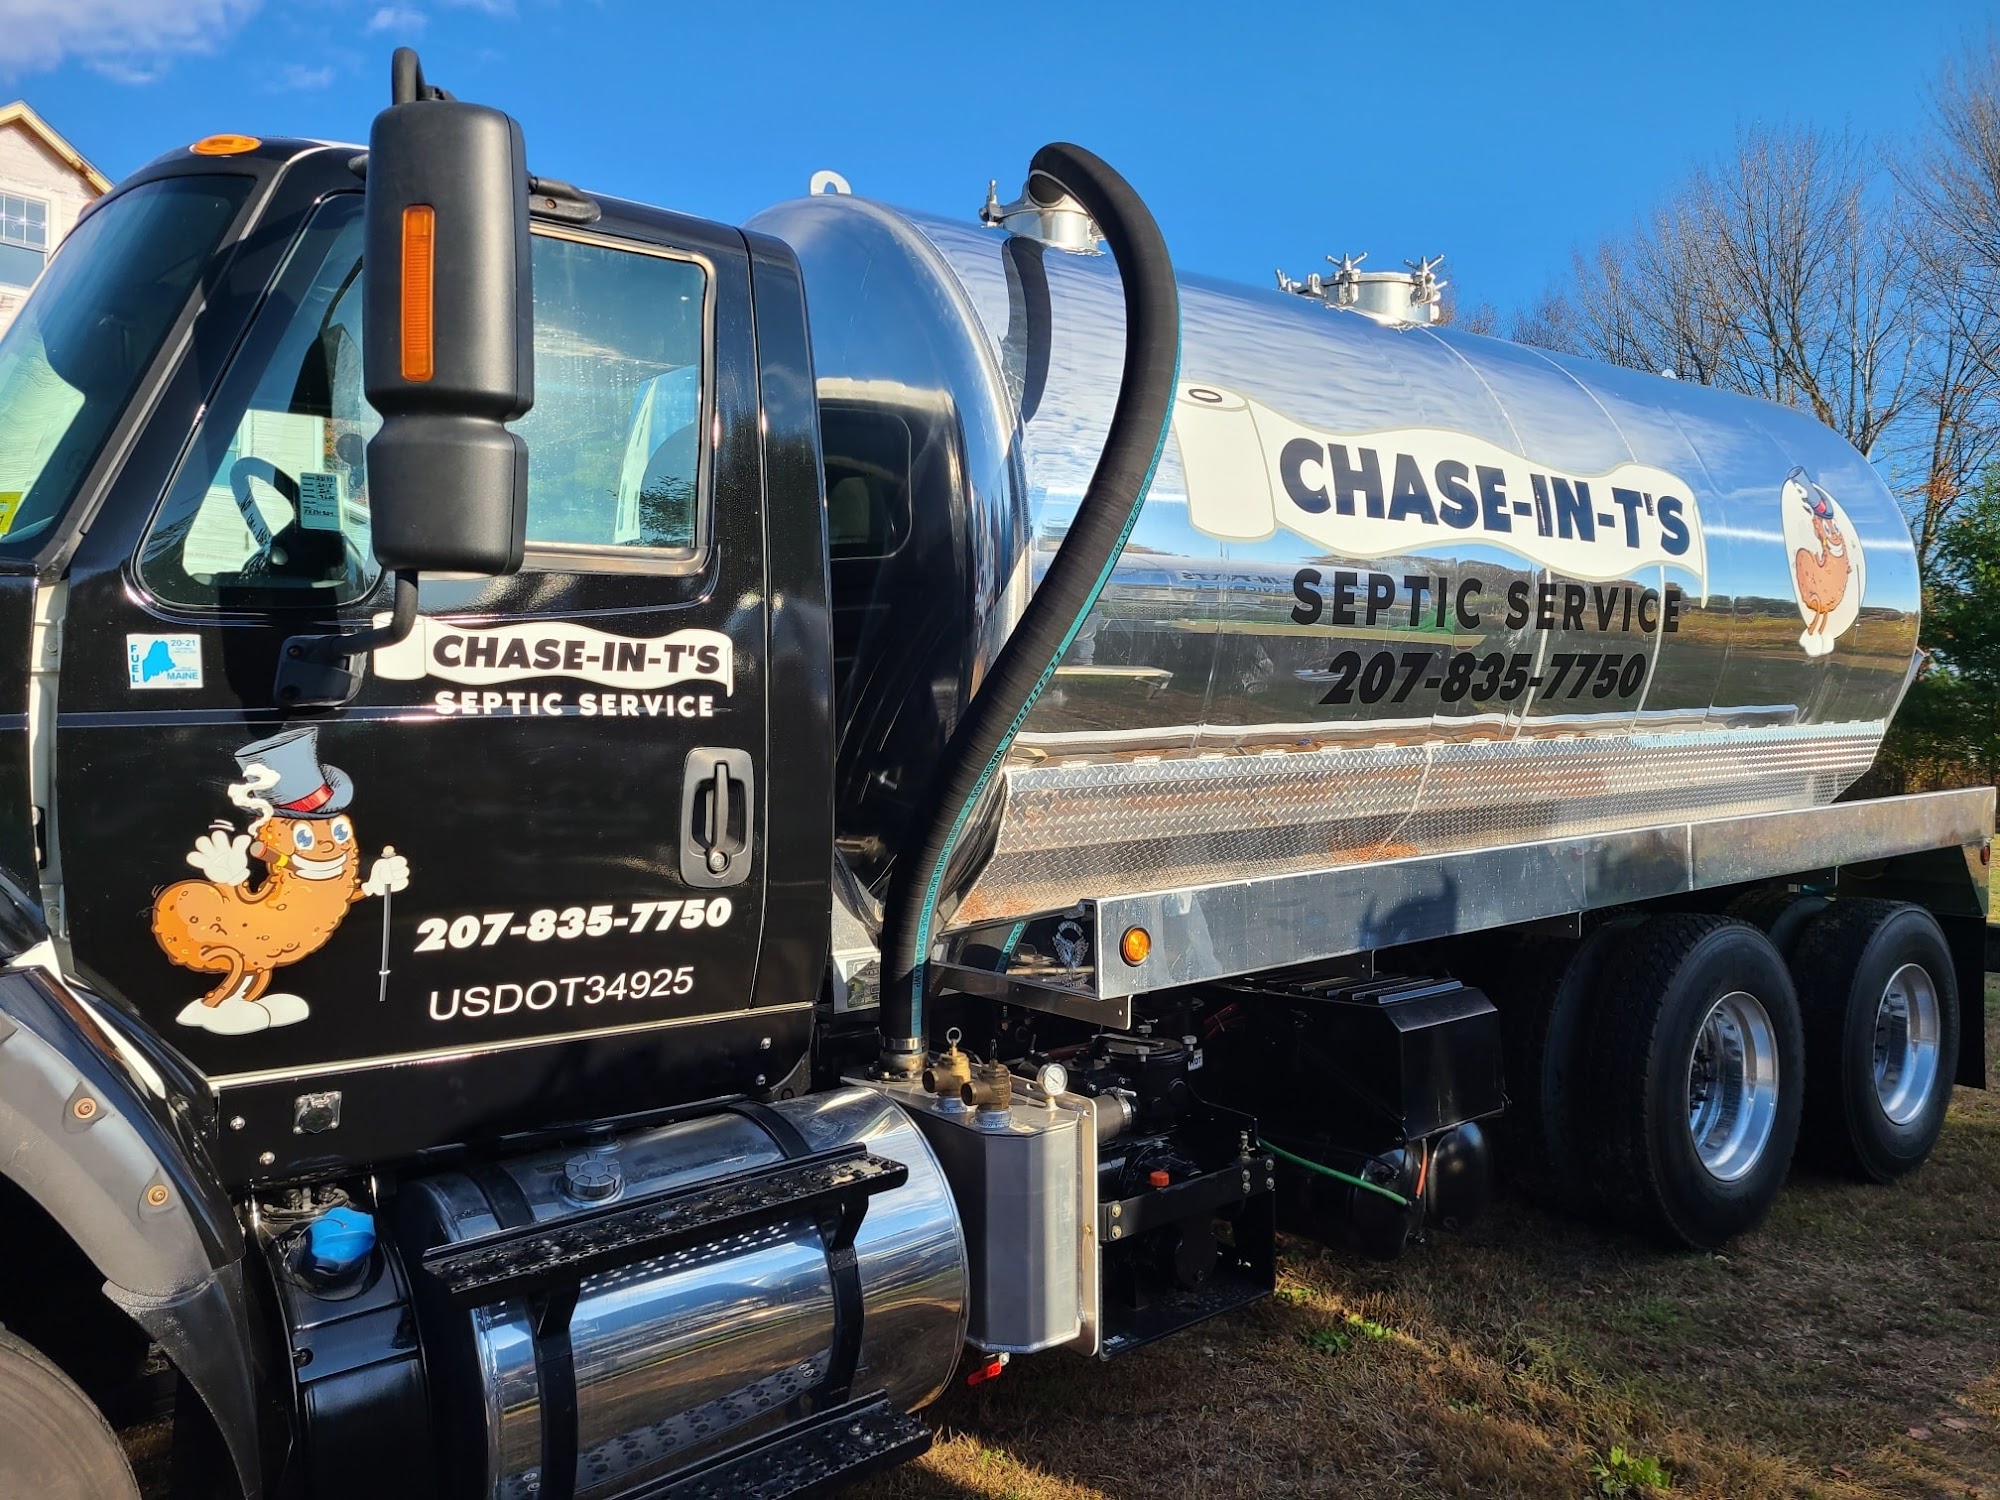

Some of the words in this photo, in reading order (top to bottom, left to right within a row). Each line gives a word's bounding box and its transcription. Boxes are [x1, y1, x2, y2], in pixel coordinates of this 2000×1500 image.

[1280, 437, 1690, 556] CHASE-IN-T'S
[1121, 518, 1135, 539] MAX
[1112, 543, 1122, 561] WP
[1291, 568, 1482, 629] SEPTIC
[1505, 580, 1682, 633] SERVICE
[131, 645, 139, 683] FUEL
[433, 635, 720, 674] CHASE-IN-T'S
[167, 672, 199, 680] MAINE
[1318, 650, 1646, 705] 207-835-7750
[435, 691, 564, 716] SEPTIC
[579, 693, 714, 717] SERVICE
[944, 818, 964, 849] RUBBER
[935, 851, 949, 875] WATER
[925, 876, 940, 907] SUCTION
[413, 897, 732, 953] 207-835-7750
[920, 908, 930, 928] HOSE
[916, 943, 925, 955] PSI
[915, 956, 924, 975] MAX
[429, 966, 695, 1021] USDOT34925
[914, 975, 922, 988] WP
